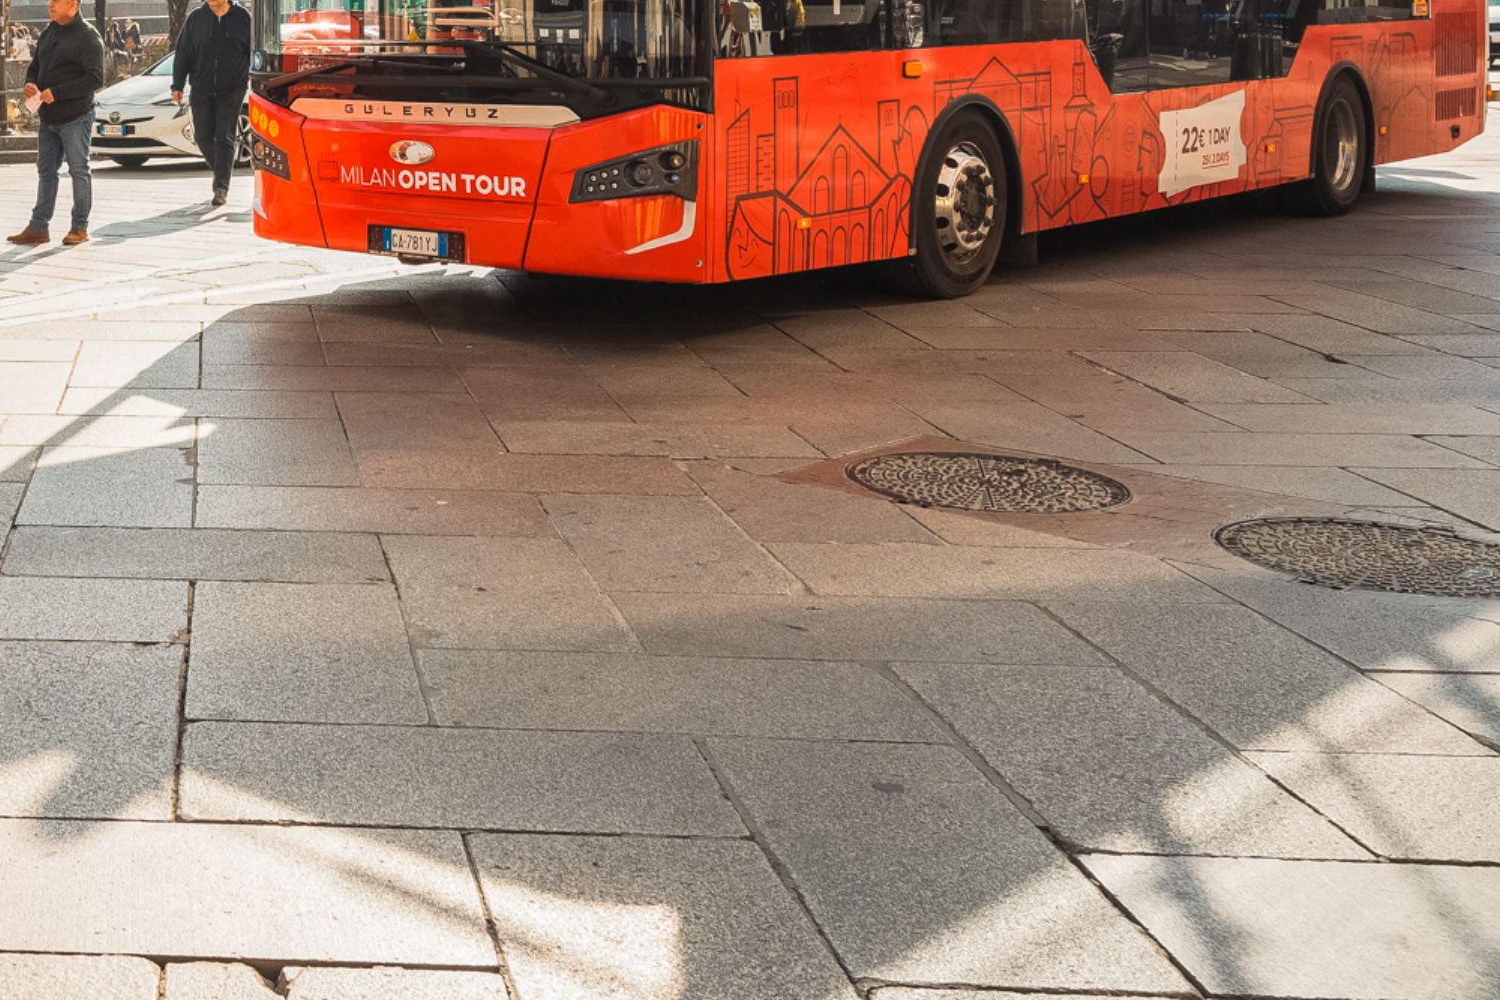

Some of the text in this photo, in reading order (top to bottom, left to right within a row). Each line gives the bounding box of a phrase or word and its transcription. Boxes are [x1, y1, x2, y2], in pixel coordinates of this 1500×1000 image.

[1181, 126, 1206, 154] 22€
[341, 165, 527, 198] MILAN OPEN TOUR
